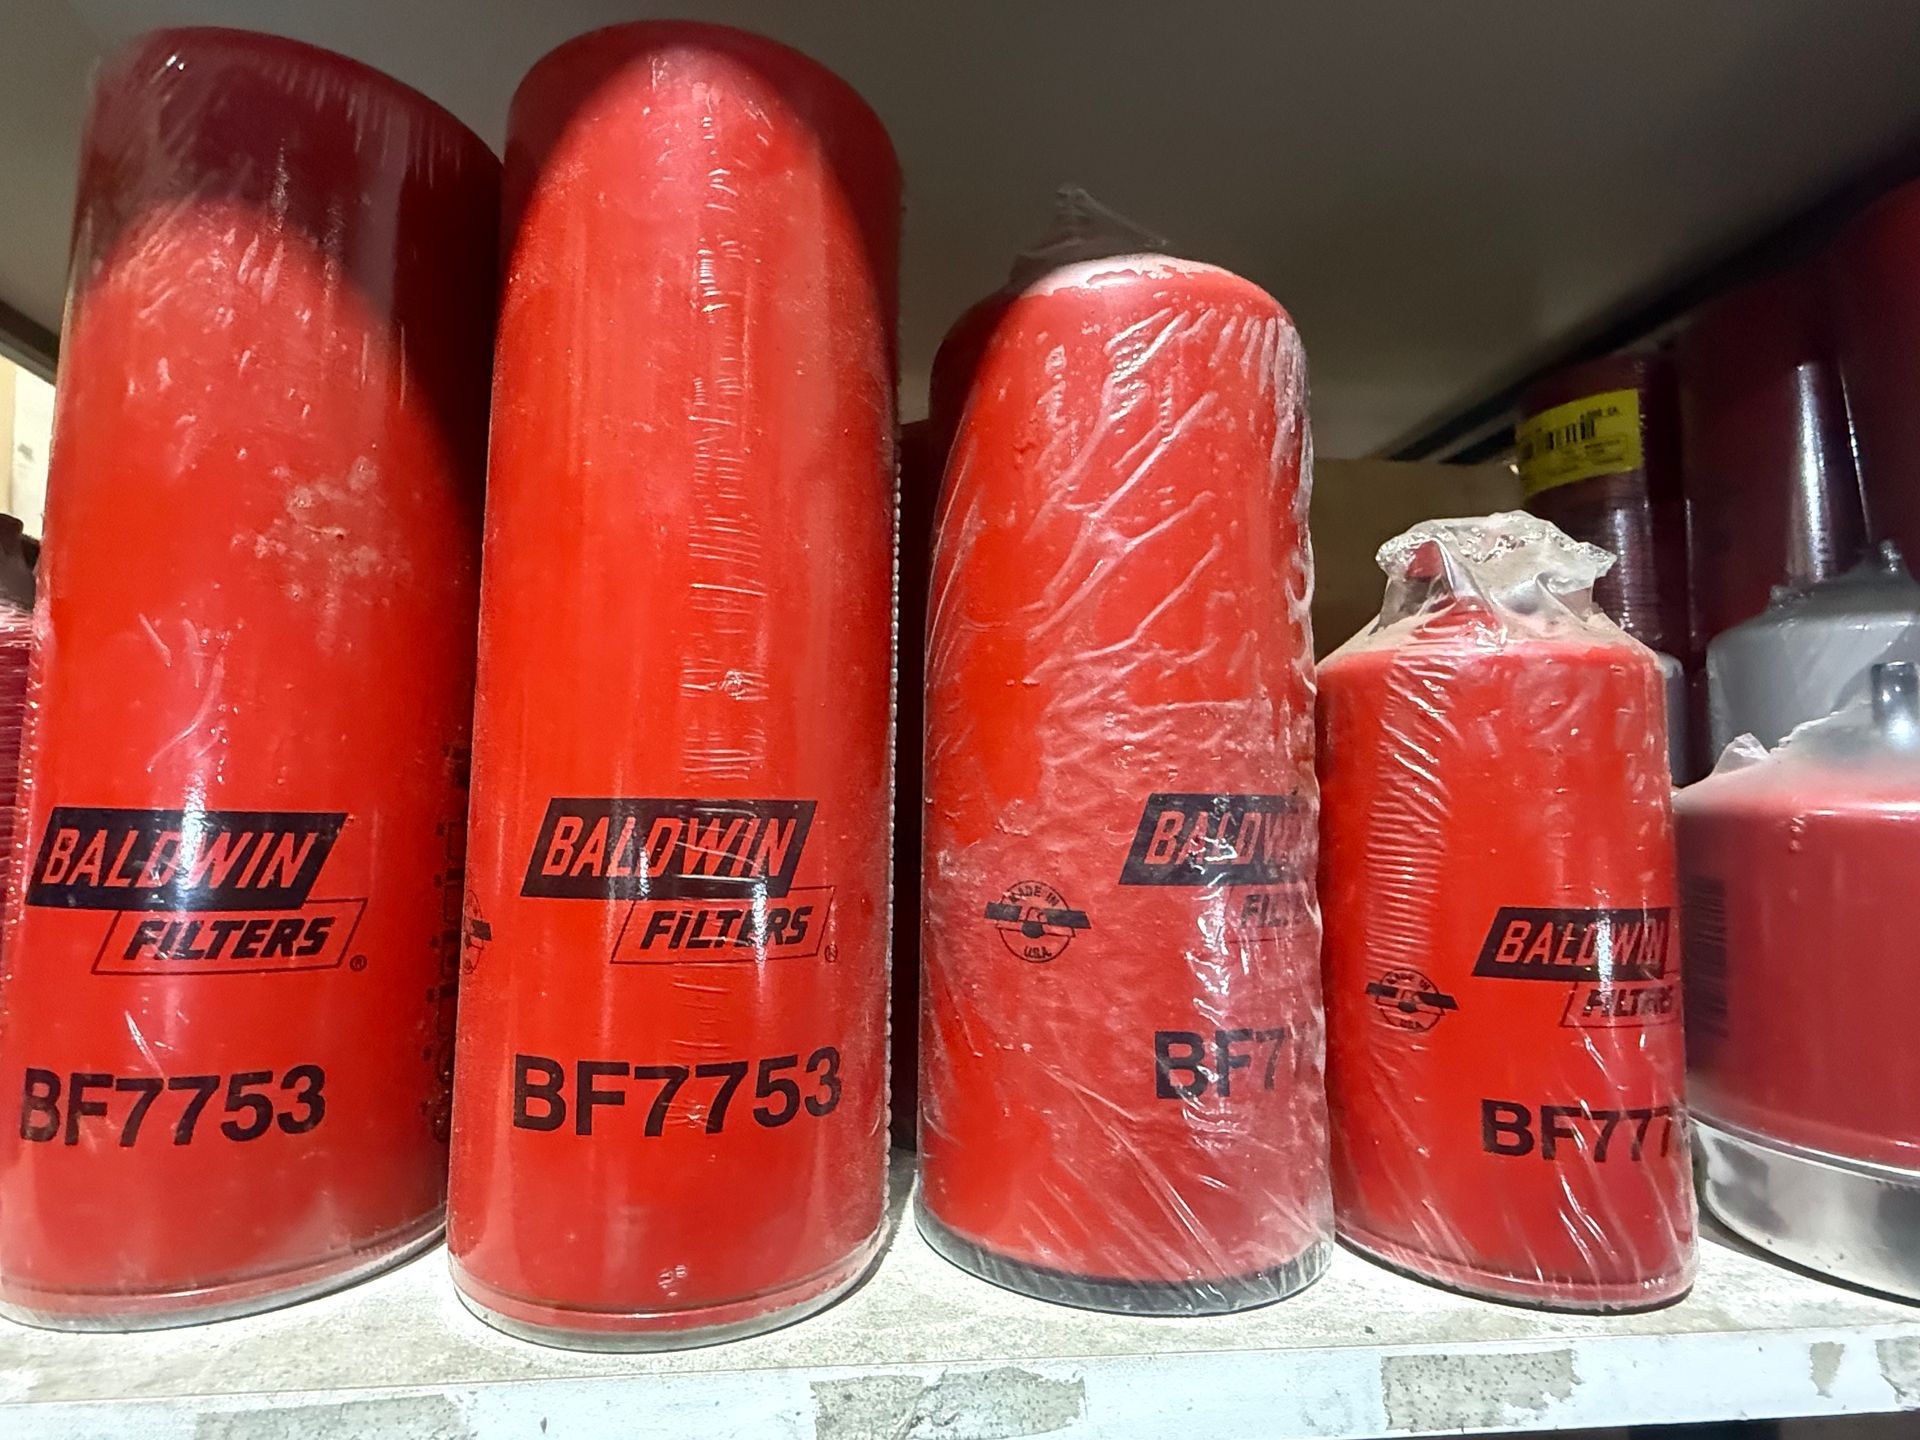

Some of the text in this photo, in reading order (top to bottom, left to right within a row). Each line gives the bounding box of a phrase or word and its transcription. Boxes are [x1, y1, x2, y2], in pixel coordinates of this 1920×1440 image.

[41, 828, 318, 890] BALDWIN
[541, 816, 798, 878] BALDWIN
[639, 906, 814, 950] FILTERS
[1045, 893, 1060, 907] IN
[123, 917, 337, 961] FILTERS
[1495, 919, 1665, 967] BALDWIN
[513, 1046, 843, 1137] BF7753
[1155, 1028, 1285, 1099] BF7
[19, 1064, 326, 1147] BF7753
